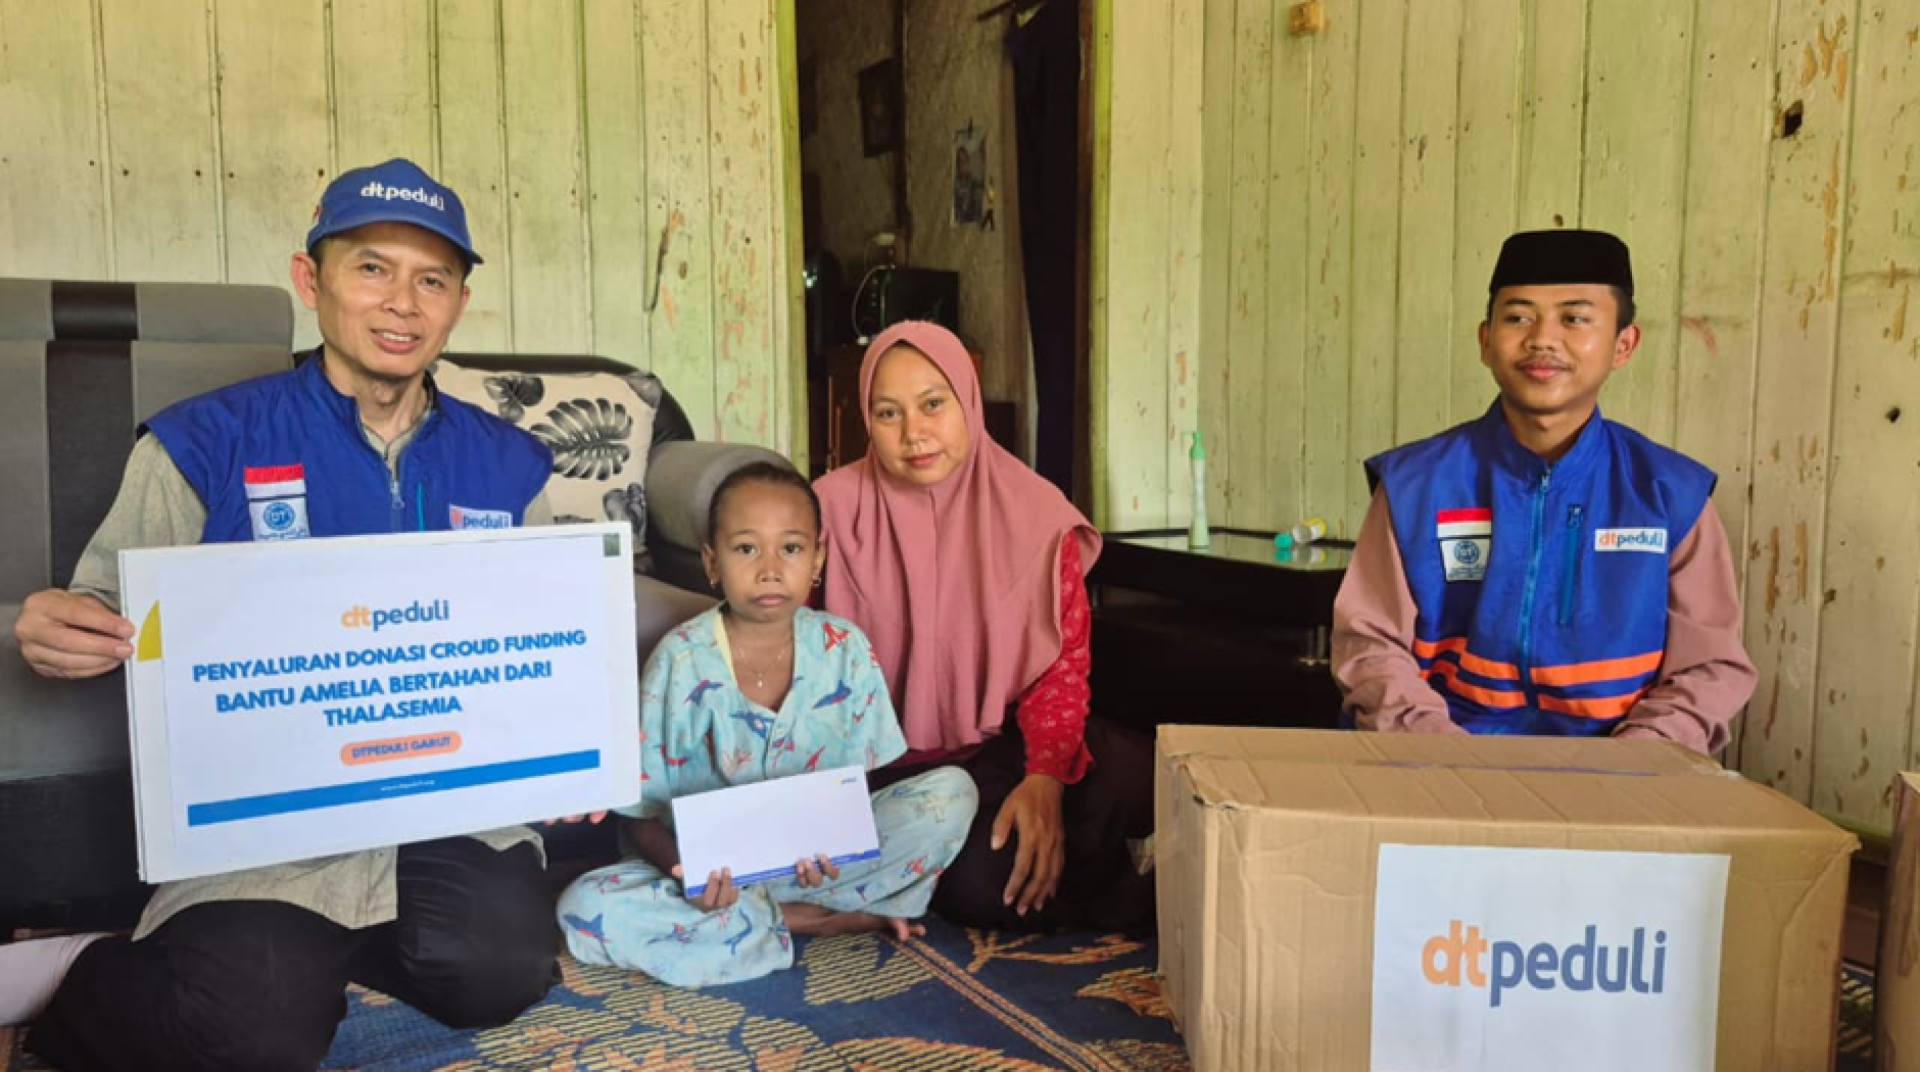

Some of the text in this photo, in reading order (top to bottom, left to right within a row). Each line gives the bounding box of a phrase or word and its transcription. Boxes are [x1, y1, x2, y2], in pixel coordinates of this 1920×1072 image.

[1599, 530, 1663, 548] dtpeduli
[341, 599, 449, 632] dtpeduli
[192, 629, 587, 682] PENYALURAN DONASI CROUD FUNDING
[216, 660, 553, 713] BANTU AMELIA BERTAHAN DARI
[323, 695, 463, 727] THALASEMIA
[351, 736, 452, 759] DTPEDULI GARUT
[1421, 919, 1667, 1007] dtpeduli
